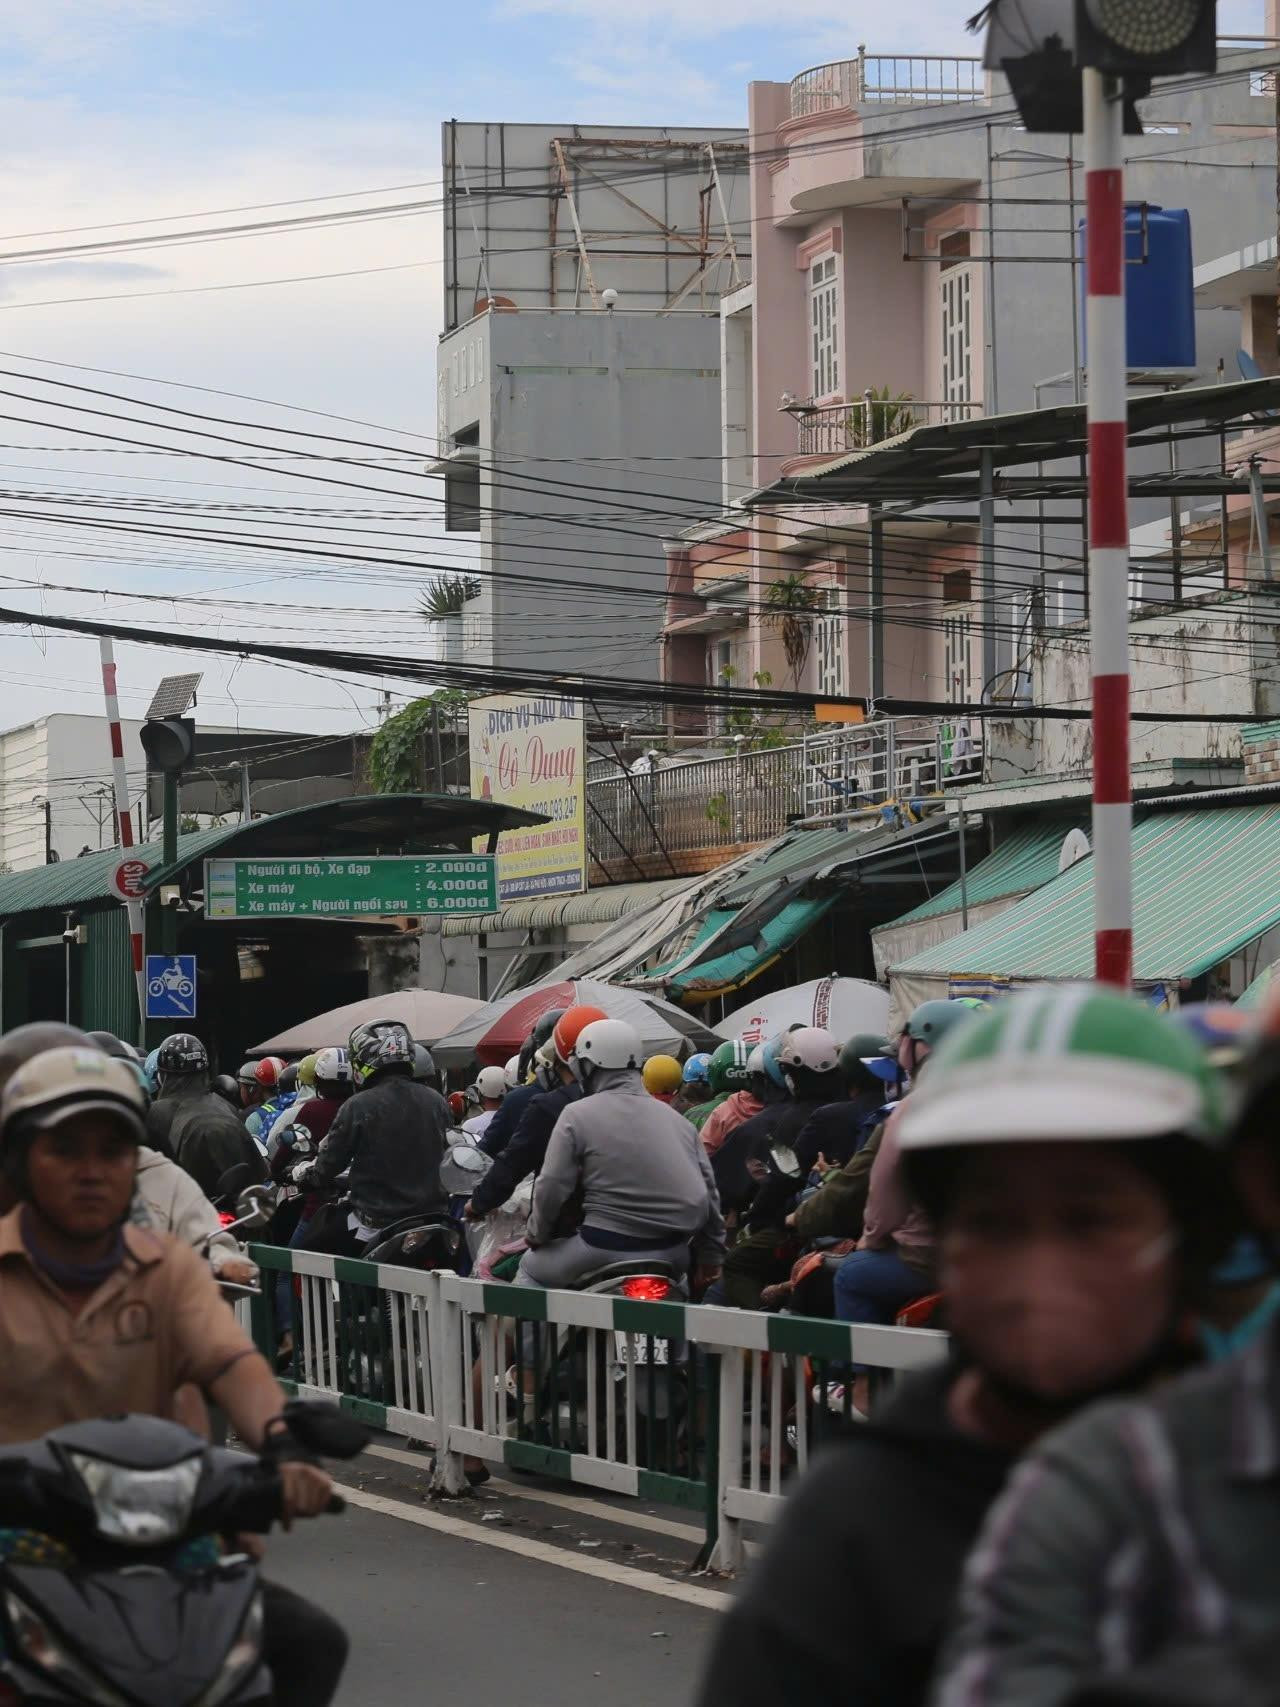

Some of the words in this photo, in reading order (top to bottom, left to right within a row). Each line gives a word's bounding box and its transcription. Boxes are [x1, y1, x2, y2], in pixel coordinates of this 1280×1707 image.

[328, 863, 344, 875] Xe
[348, 863, 371, 877] đạp
[425, 862, 487, 873] 2.000đ
[248, 882, 264, 894] Xe
[268, 881, 295, 895] máy
[426, 879, 488, 891] 4.000đ
[248, 900, 265, 912] Xe
[268, 899, 295, 912] máy
[385, 899, 408, 910] sau
[427, 897, 489, 909] 6.000đ
[725, 1067, 752, 1080] Gra
